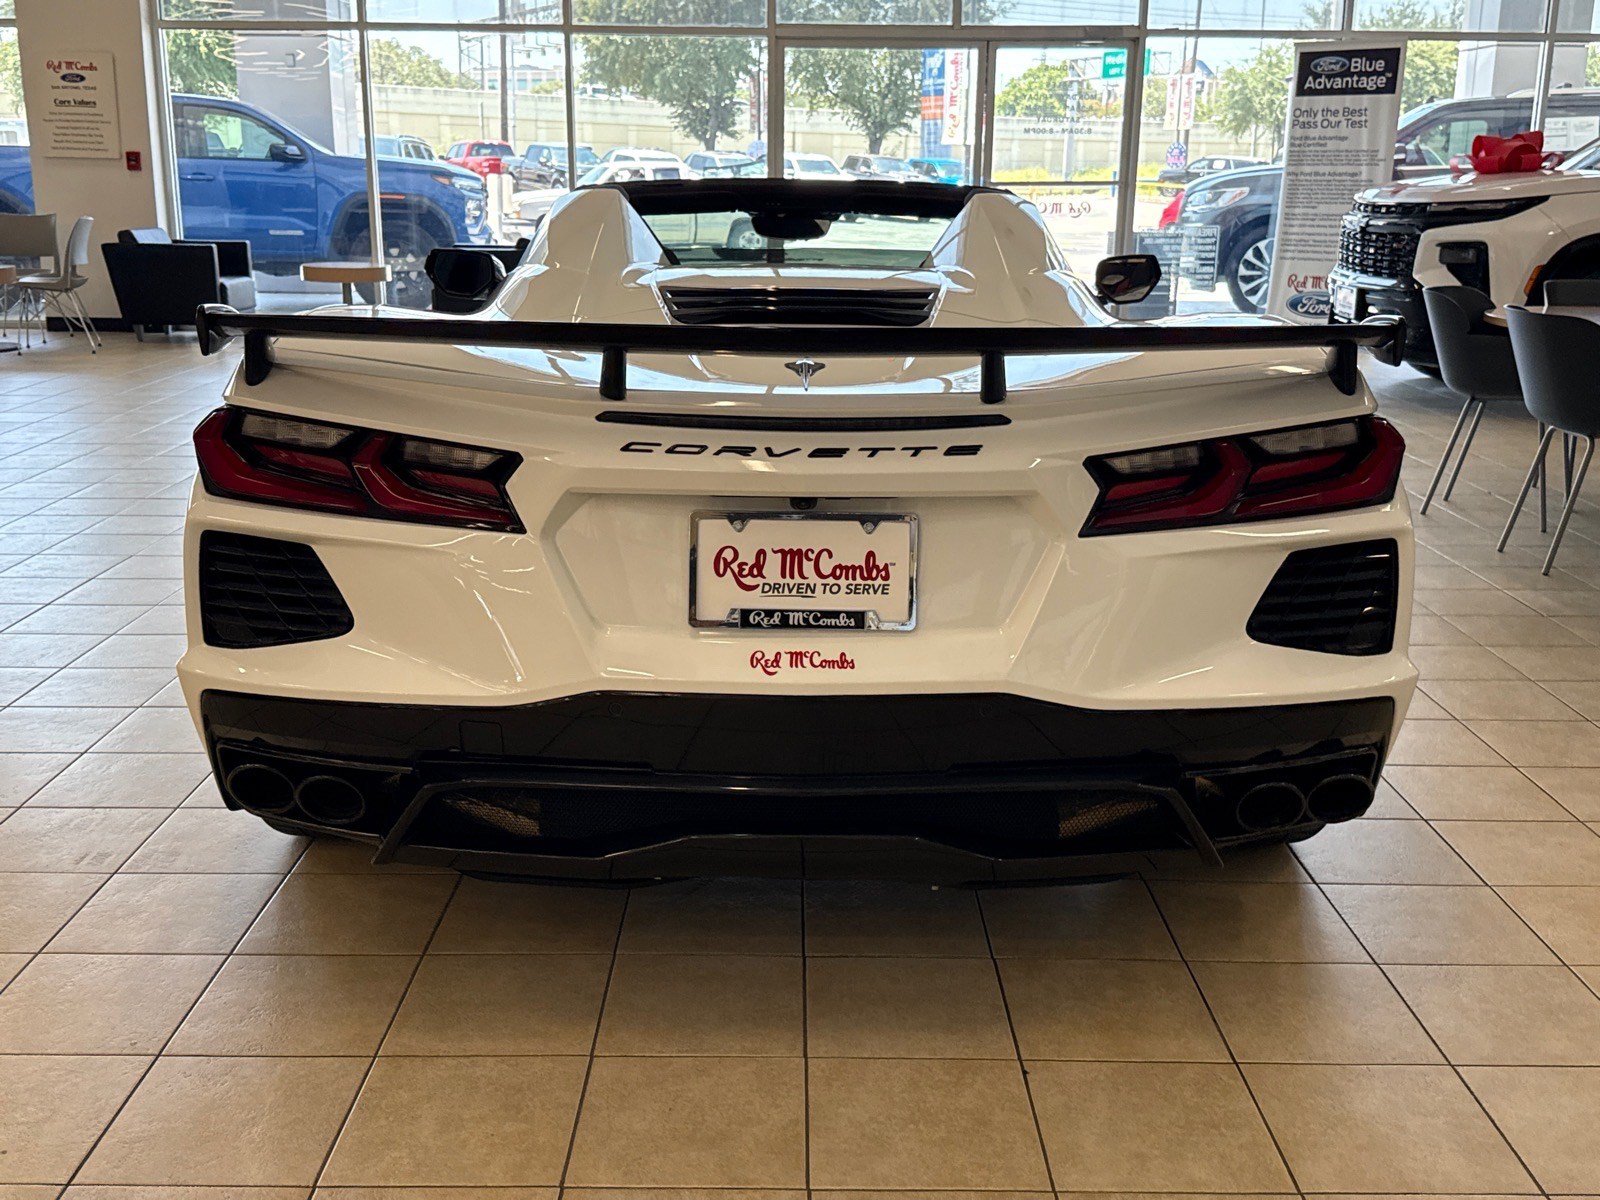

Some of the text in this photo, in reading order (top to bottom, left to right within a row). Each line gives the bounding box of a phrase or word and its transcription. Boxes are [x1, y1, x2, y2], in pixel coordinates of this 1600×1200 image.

[1315, 57, 1386, 72] Ford Blue
[54, 98, 97, 106] Core Values
[1293, 107, 1368, 119] Only the Best
[1292, 118, 1368, 129] Pass Our Test
[1287, 274, 1308, 293] Red
[619, 441, 984, 458] CORVETTE
[713, 545, 891, 592] Red McCombs
[760, 582, 890, 596] DRIVEN TO SERVE
[749, 610, 856, 628] Red McCombs
[750, 650, 856, 676] Red McCombs
